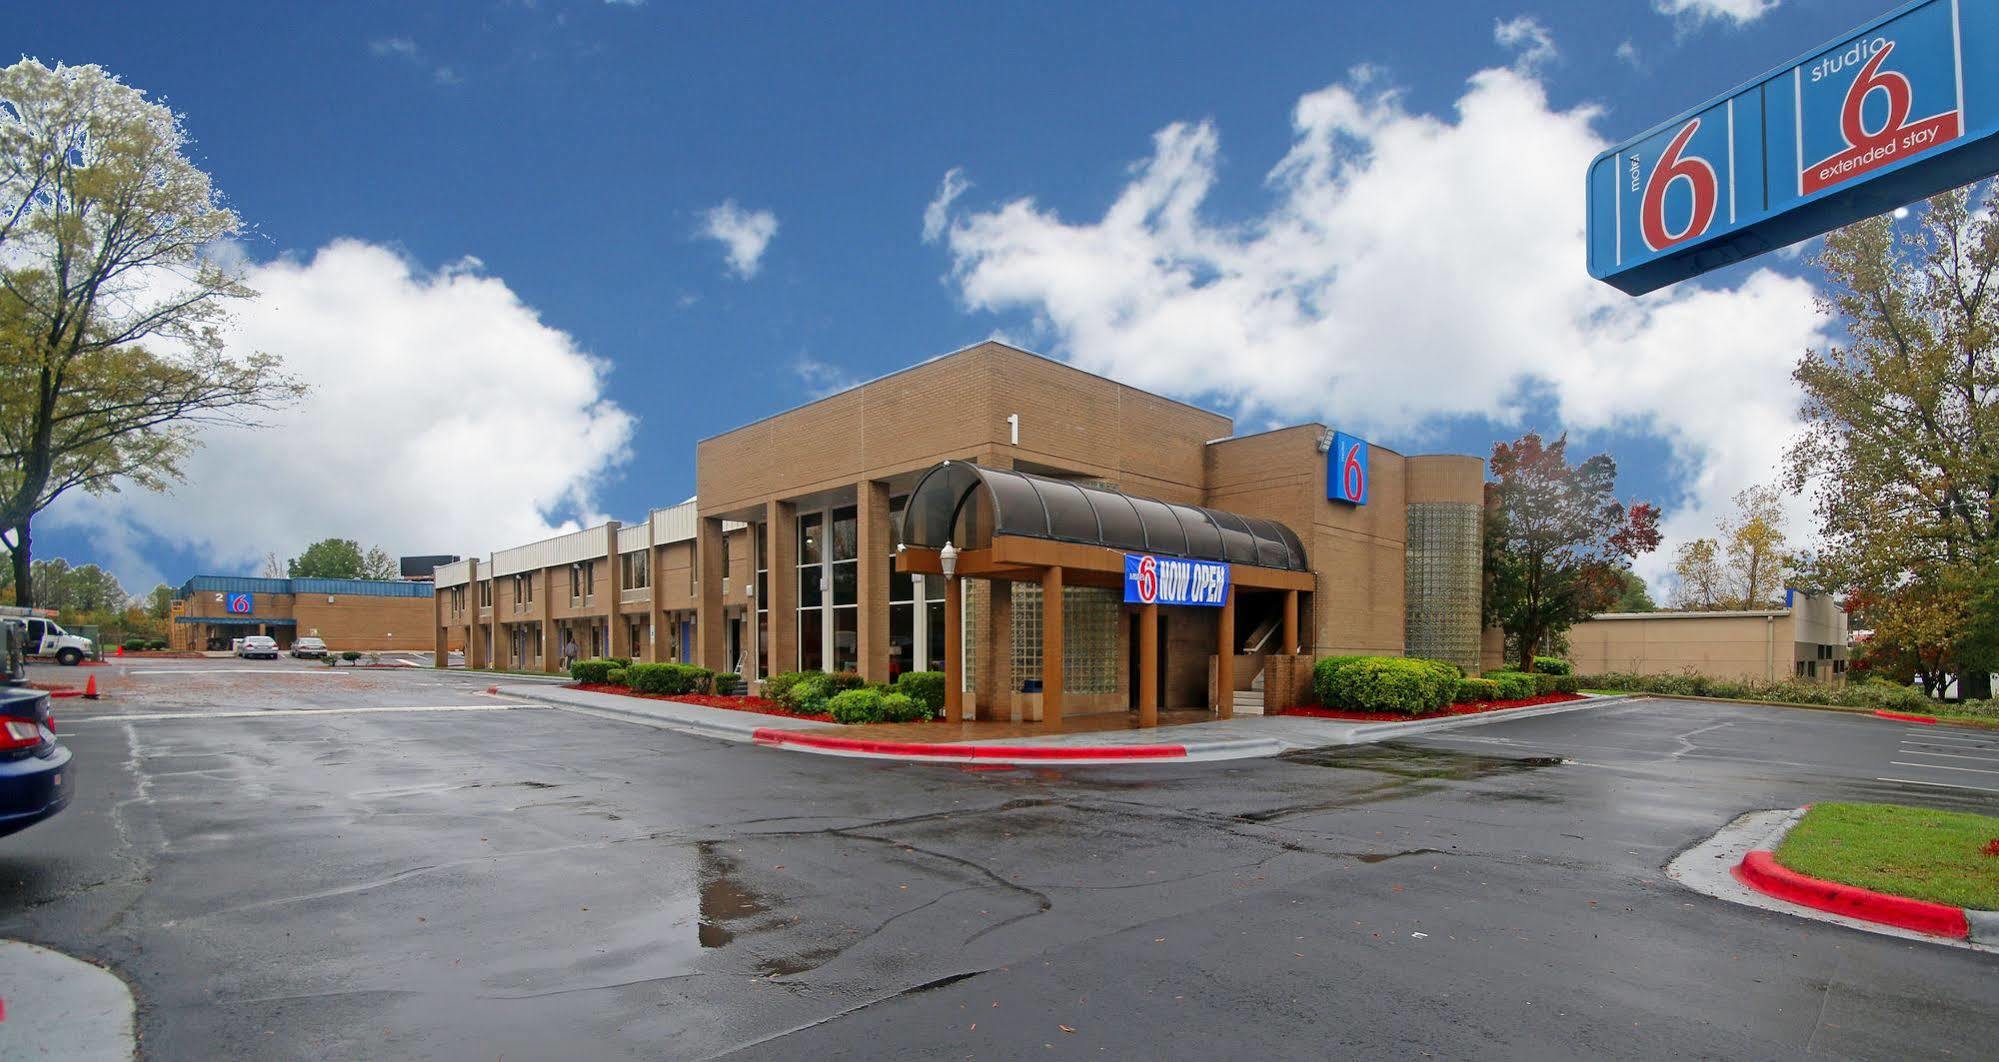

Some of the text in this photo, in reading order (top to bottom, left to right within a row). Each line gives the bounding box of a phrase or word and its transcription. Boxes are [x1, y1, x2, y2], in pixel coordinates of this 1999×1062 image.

[1811, 37, 1886, 82] studio
[1840, 40, 1912, 147] 6
[1819, 124, 1939, 180] extended stay
[1640, 118, 1718, 252] 6
[1007, 414, 1018, 445] 1
[1343, 442, 1363, 503] 6
[215, 593, 224, 602] 2
[233, 594, 249, 612] 6
[1138, 556, 1225, 603] 6 NOW OPEN
